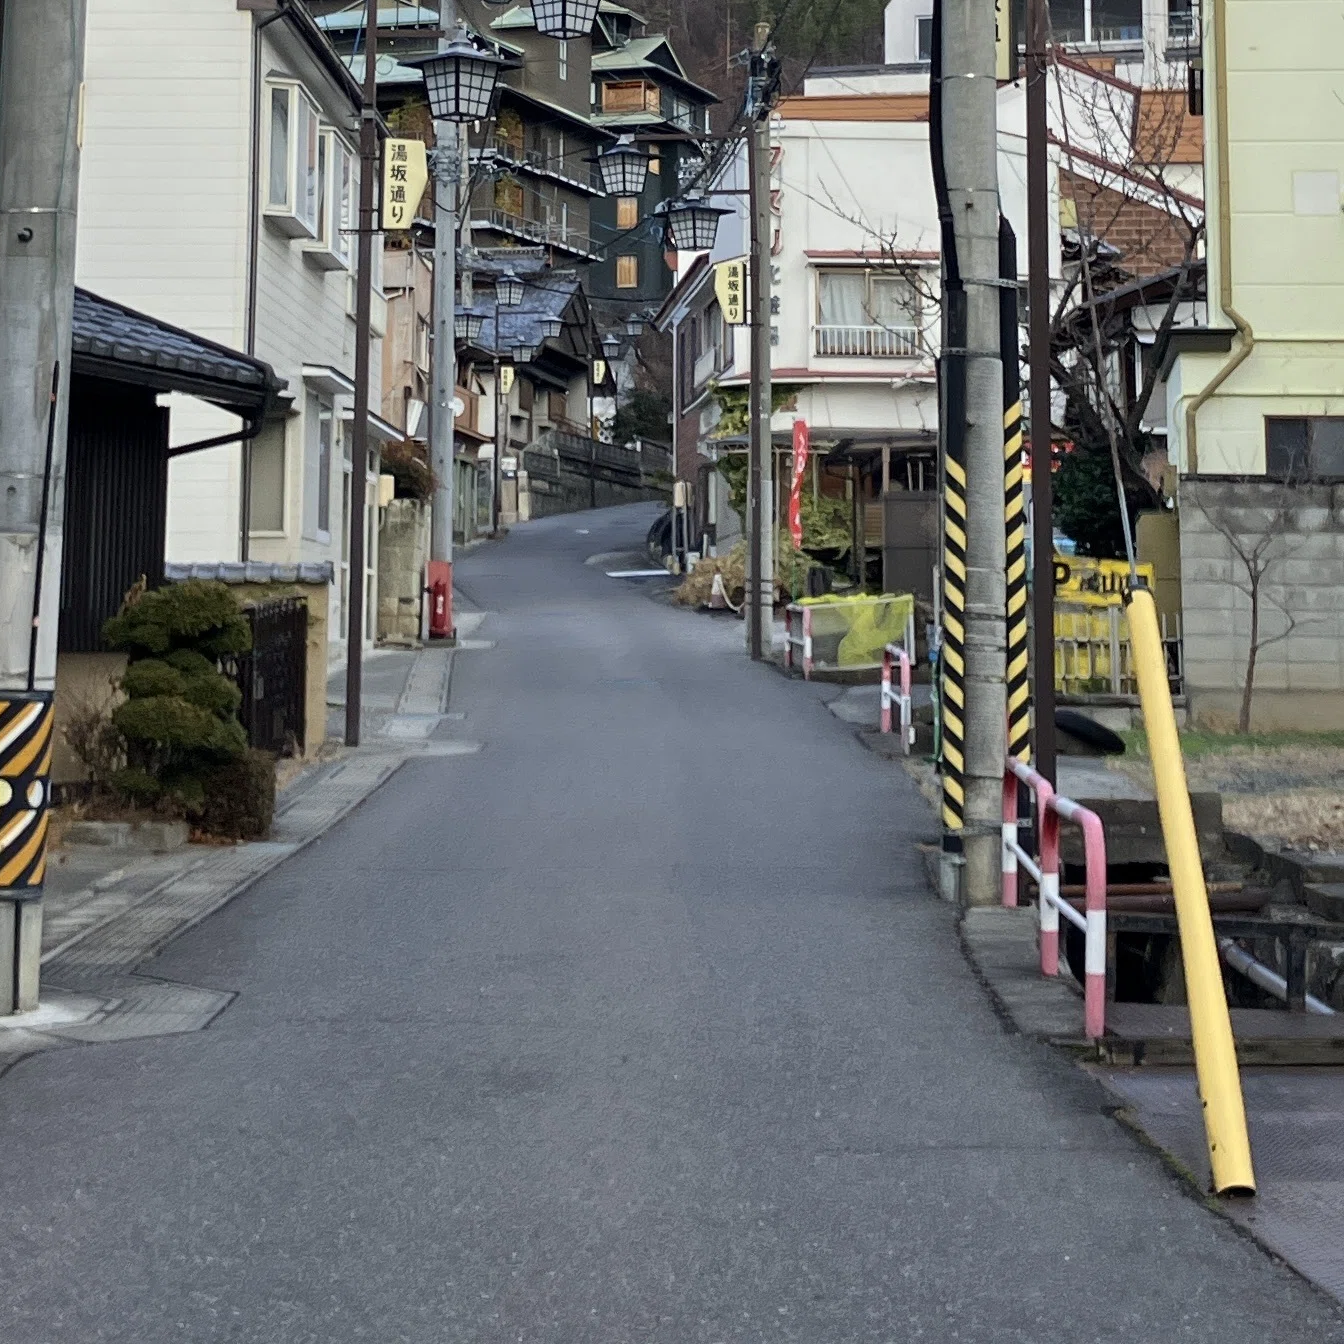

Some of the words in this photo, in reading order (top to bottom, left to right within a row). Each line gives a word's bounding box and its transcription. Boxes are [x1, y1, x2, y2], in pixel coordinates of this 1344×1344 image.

[390, 144, 408, 223] 湯坂通り
[728, 266, 739, 320] 湯坂通り
